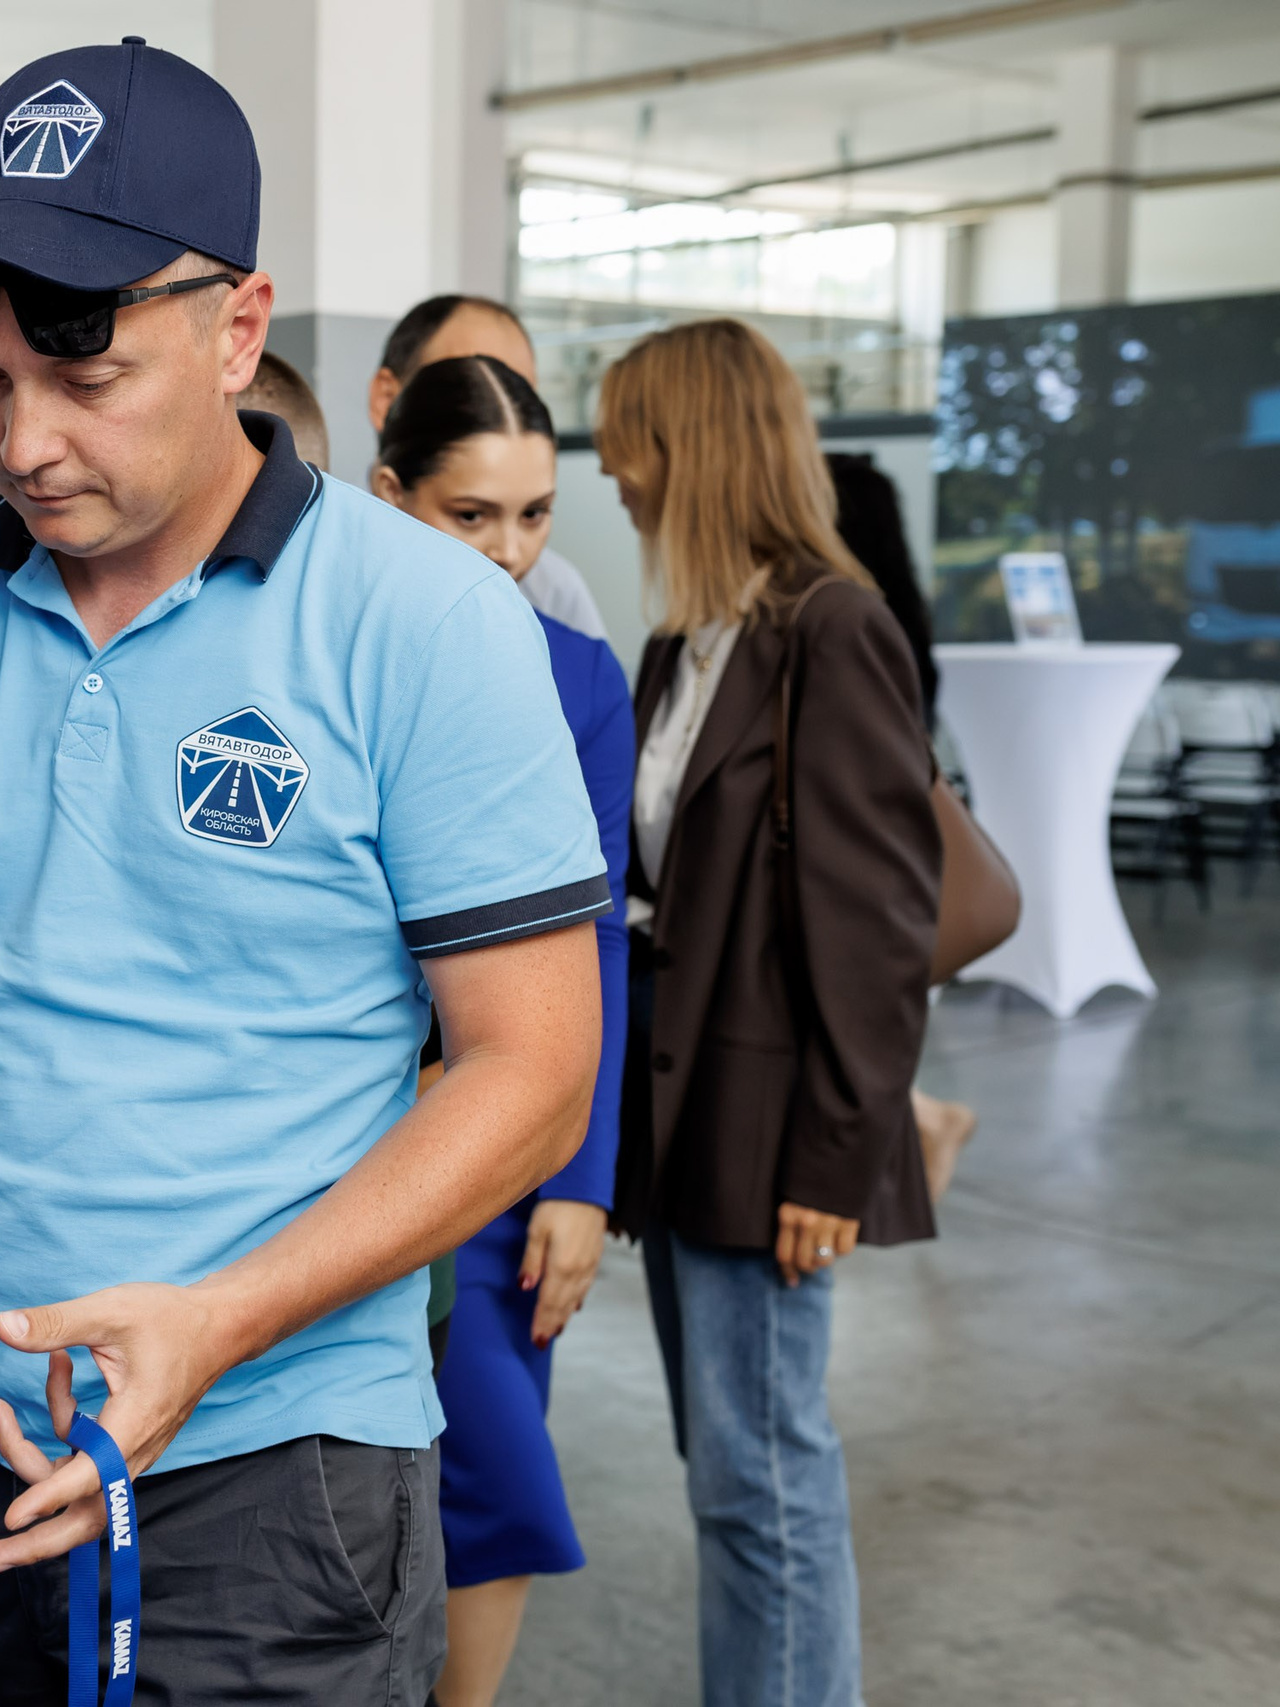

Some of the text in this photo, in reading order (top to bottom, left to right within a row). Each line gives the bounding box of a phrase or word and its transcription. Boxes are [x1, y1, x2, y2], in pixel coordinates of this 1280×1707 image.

[18, 105, 91, 116] ВЯТАВТОДОР
[198, 733, 292, 761] ВЯТАВТОДОР
[200, 807, 260, 827] КИРОВСКАЯ
[205, 819, 251, 835] ОБЛАСТЬ
[108, 1478, 131, 1551] KAMAZ
[113, 1618, 132, 1679] KAMAZ
